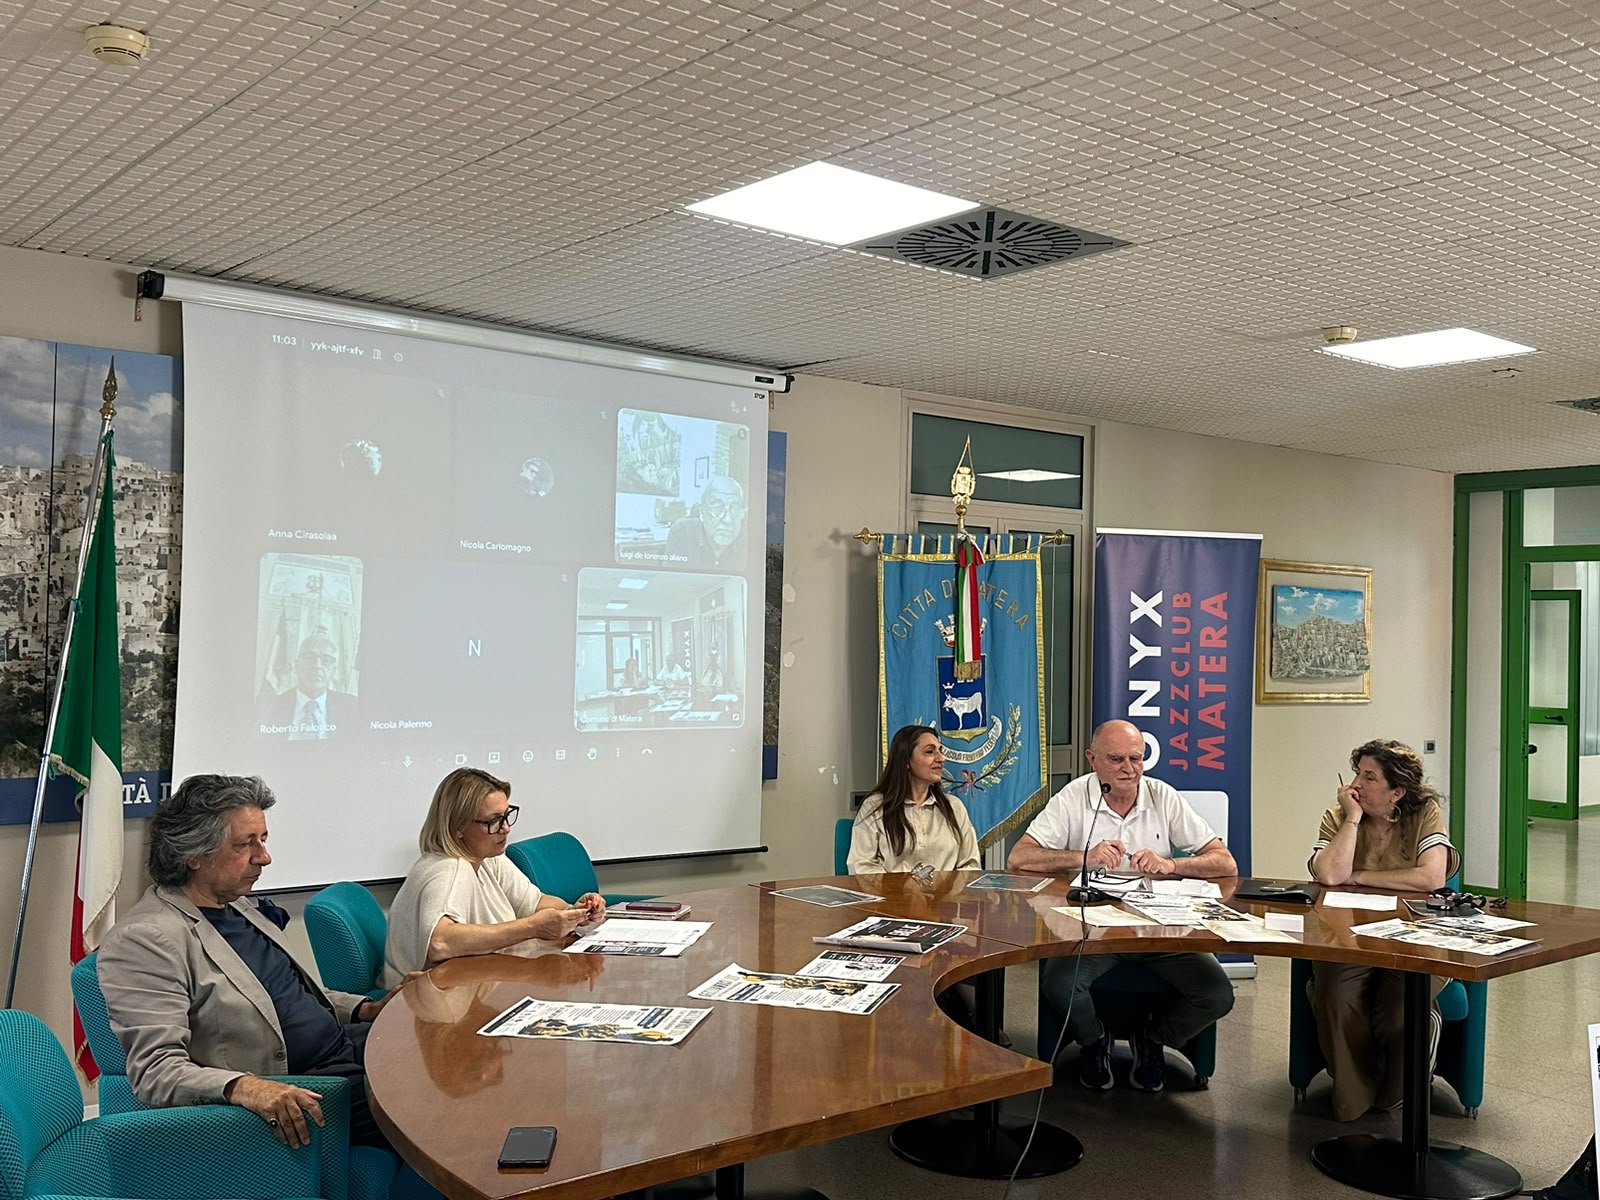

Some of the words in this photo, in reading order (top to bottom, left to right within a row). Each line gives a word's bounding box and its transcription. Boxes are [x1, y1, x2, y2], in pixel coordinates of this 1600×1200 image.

[272, 334, 297, 346] 11:03
[268, 528, 293, 539] Anna
[460, 540, 484, 550] Nicola
[978, 580, 1029, 631] ATERA
[468, 639, 481, 657] N
[1128, 590, 1163, 772] ONYX
[1197, 592, 1228, 770] MATERA
[260, 723, 298, 735] Roberto
[300, 722, 337, 733] Faloco
[370, 720, 397, 730] Nicola
[398, 719, 433, 729] Palermo
